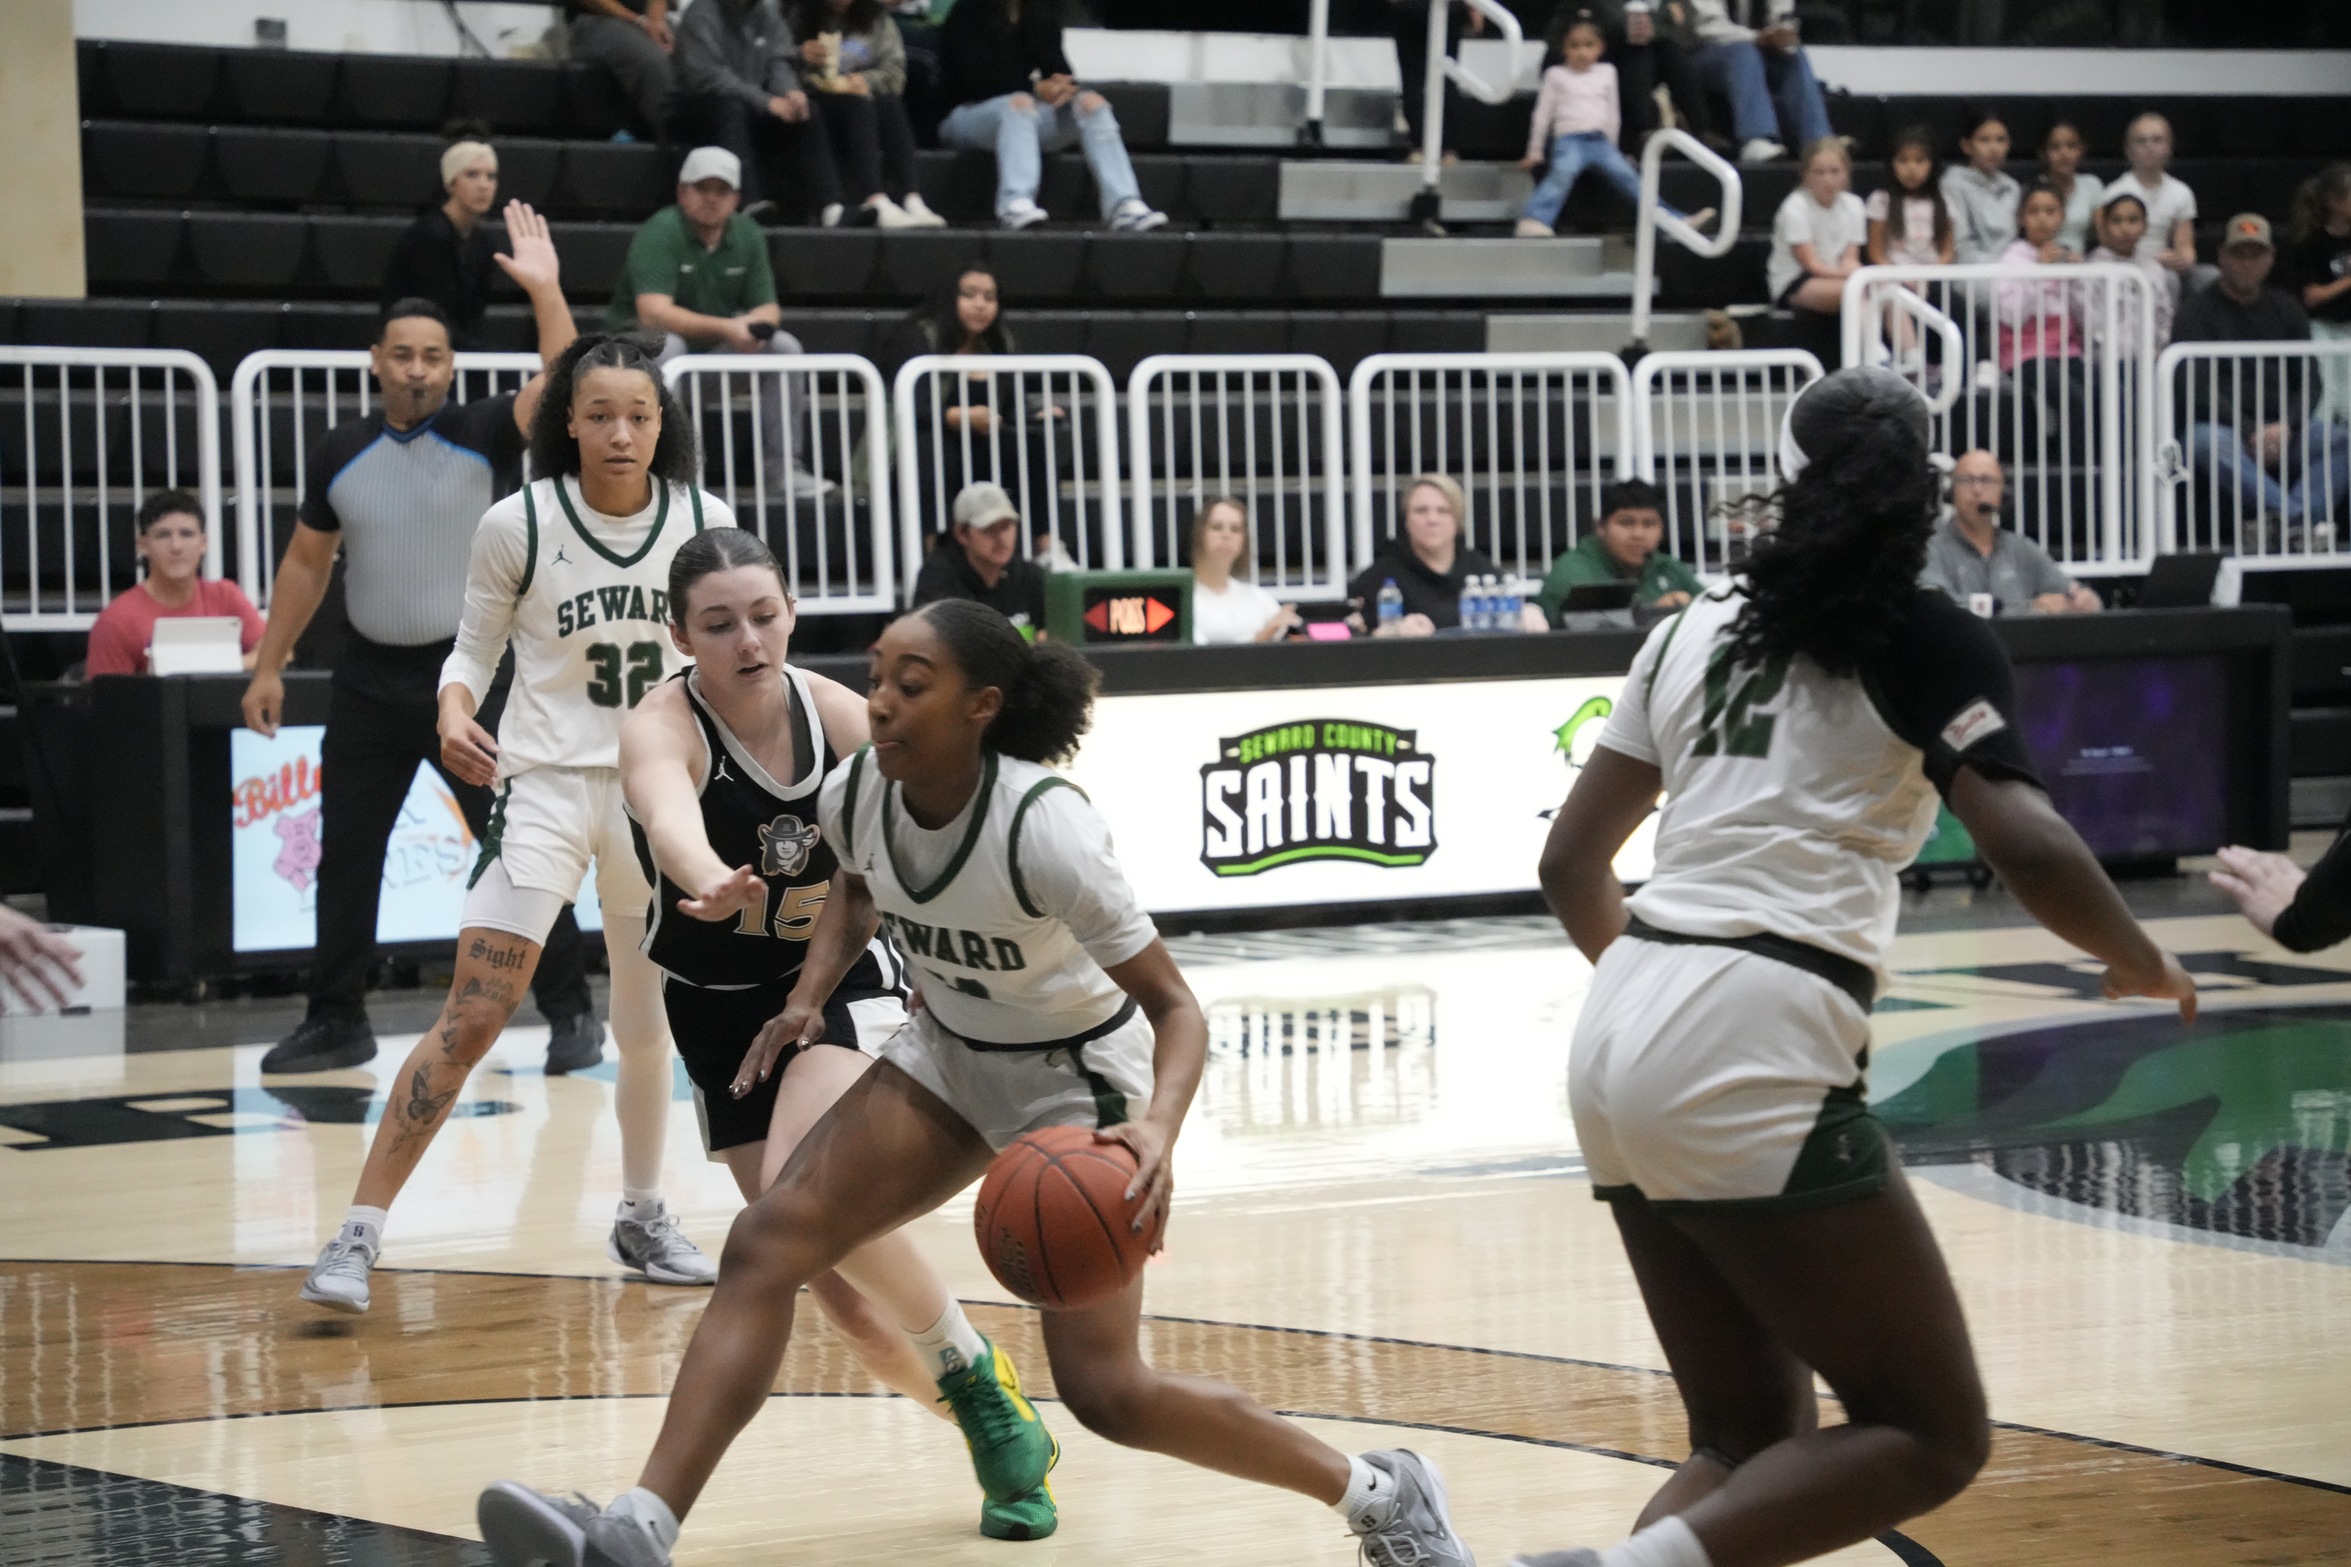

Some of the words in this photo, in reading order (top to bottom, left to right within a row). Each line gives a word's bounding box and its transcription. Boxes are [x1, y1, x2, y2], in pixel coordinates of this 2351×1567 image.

[557, 584, 670, 639] SEWAR
[585, 640, 664, 710] 32
[1239, 724, 1316, 764] SEWARD
[1323, 723, 1398, 756] COUNTY
[233, 754, 322, 829] Bill
[1205, 752, 1432, 858] SAINTS
[732, 879, 830, 942] 15
[882, 909, 1027, 972] EWARD
[468, 937, 527, 974] Sight
